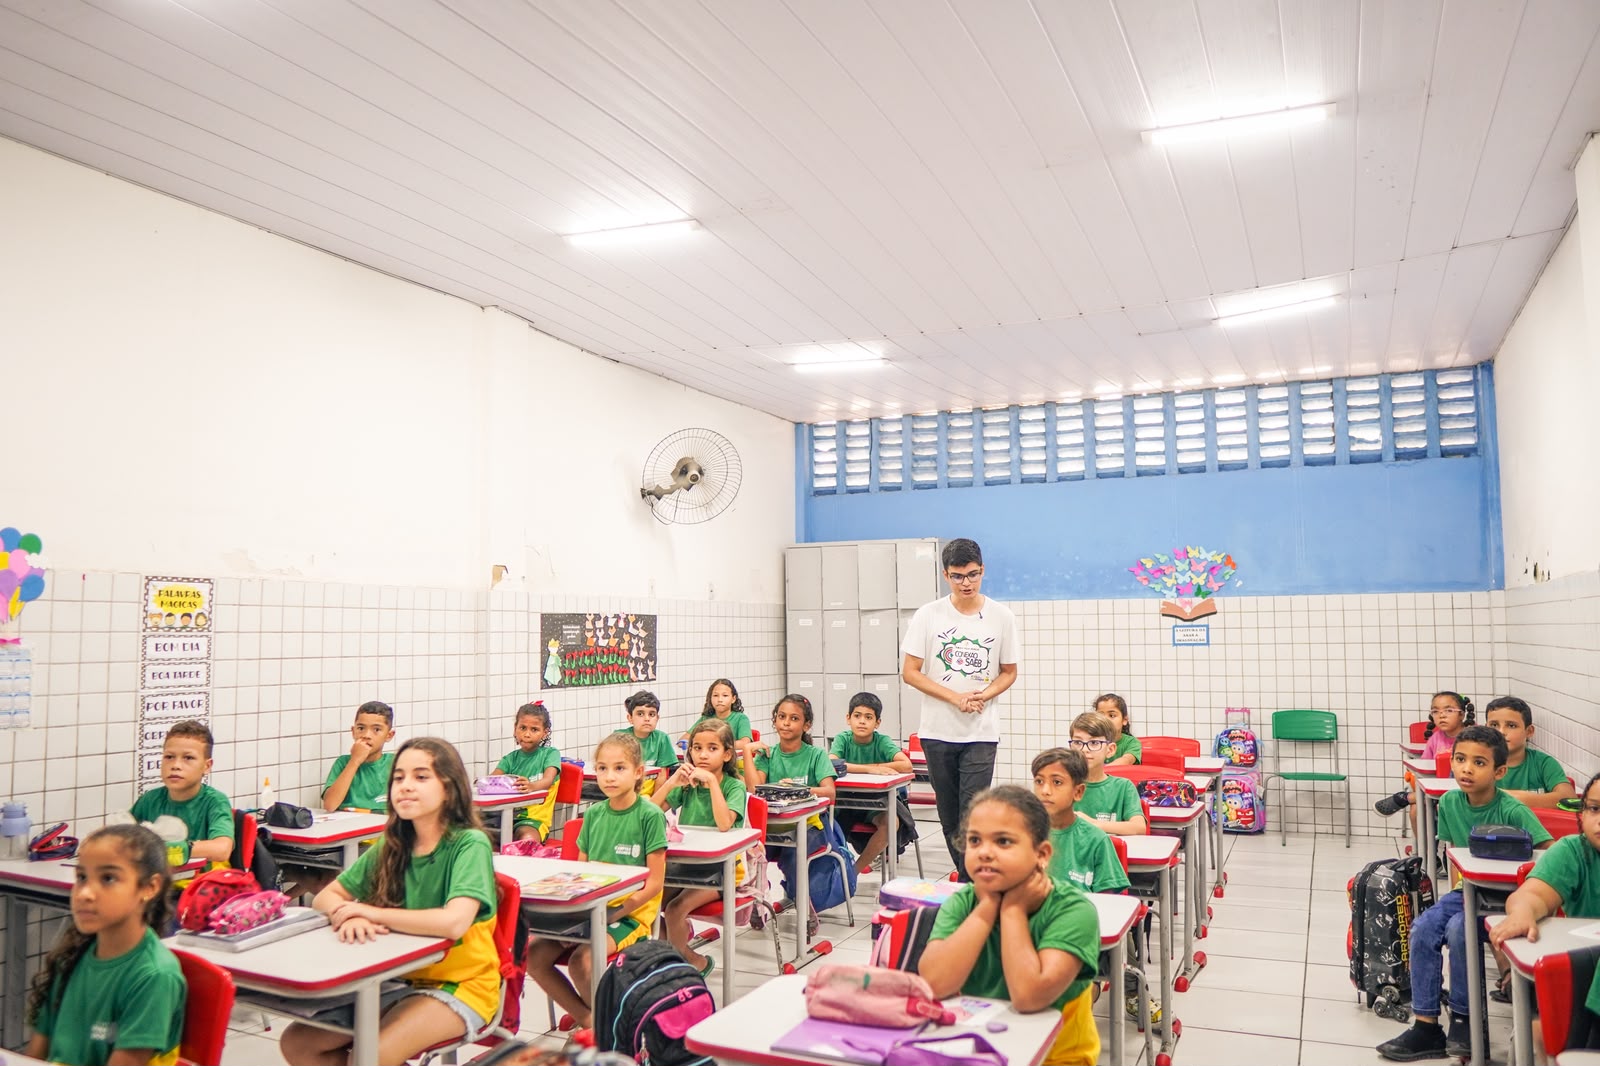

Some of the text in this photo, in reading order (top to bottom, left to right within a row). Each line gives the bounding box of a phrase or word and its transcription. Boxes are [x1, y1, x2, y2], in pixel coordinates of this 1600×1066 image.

[158, 589, 201, 598] PALAVRAS
[155, 642, 200, 652] BOM DIA
[965, 657, 983, 668] SAEB
[151, 670, 201, 680] BOA TARDE
[146, 699, 204, 712] POR FAVOR
[1396, 894, 1408, 962] ARMORED
